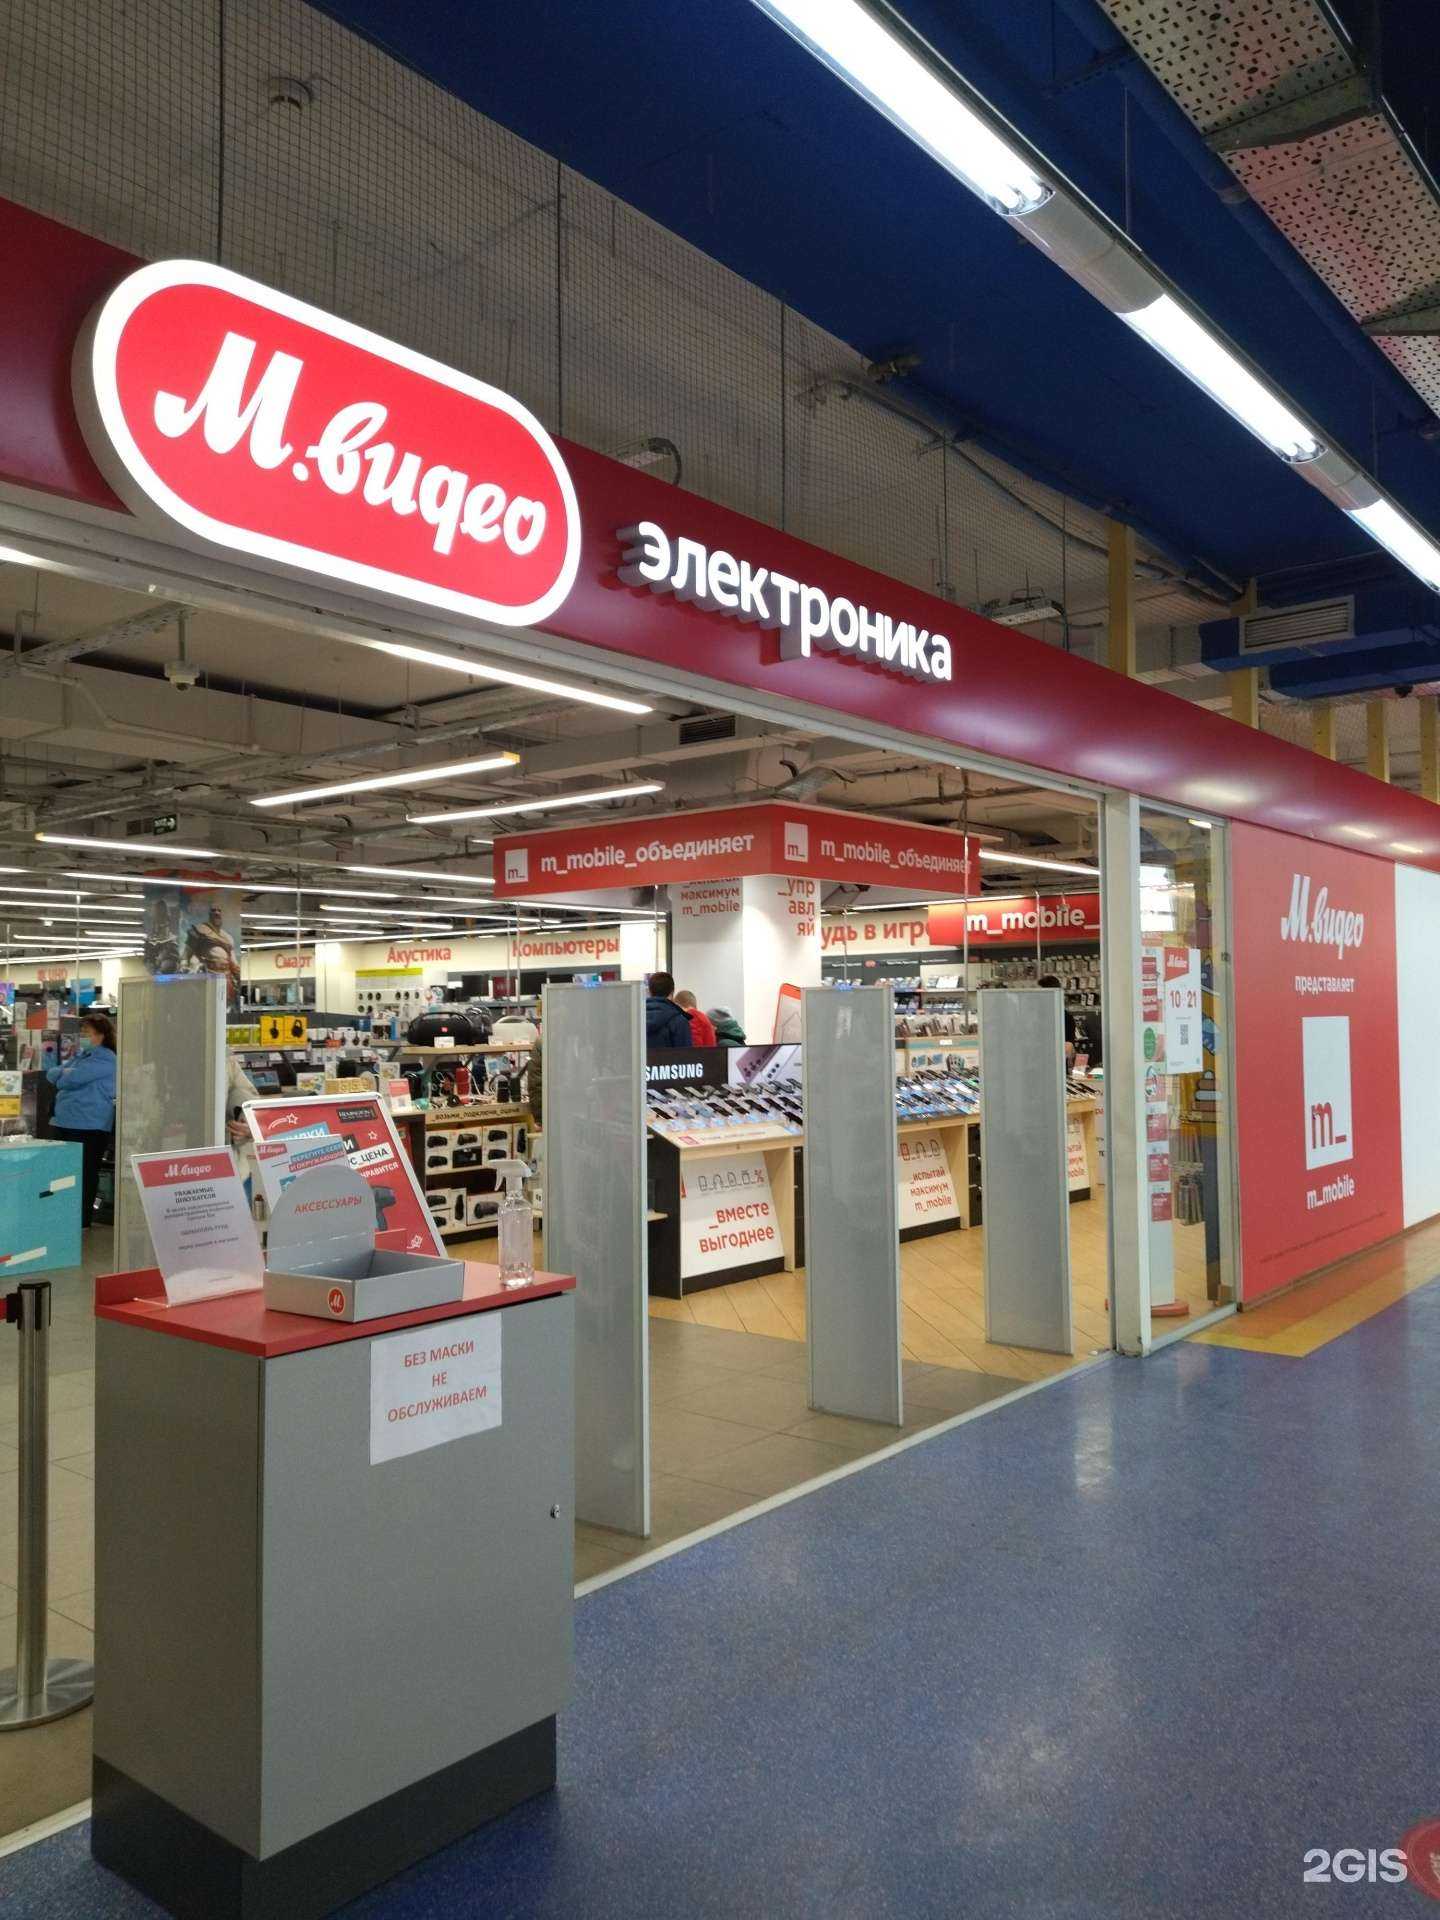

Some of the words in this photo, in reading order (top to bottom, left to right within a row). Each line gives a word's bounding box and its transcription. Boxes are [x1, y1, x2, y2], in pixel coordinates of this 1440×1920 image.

[154, 331, 546, 556] М.видео
[638, 521, 952, 681] электроника
[541, 834, 754, 875] m_mobile_объединяет
[680, 887, 740, 900] максимум
[682, 901, 740, 916] m_mobile
[788, 900, 815, 915] авл
[1281, 873, 1364, 960] М.видео
[512, 936, 619, 960] Компьютеры
[820, 922, 857, 949] удь
[864, 924, 876, 941] в
[387, 946, 452, 968] Акустика
[1295, 975, 1355, 996] представляет
[645, 1063, 704, 1081] SAMSUNG
[1306, 1173, 1355, 1210] m_mobile
[294, 1195, 363, 1214] АКСЕССУАРЫ
[698, 1226, 775, 1253] выгоднее
[404, 1351, 427, 1368] БЕЗ
[430, 1340, 475, 1363] МАСКИ
[432, 1371, 448, 1387] НЕ
[387, 1385, 488, 1423] ОБСЛУЖИВАЕМ
